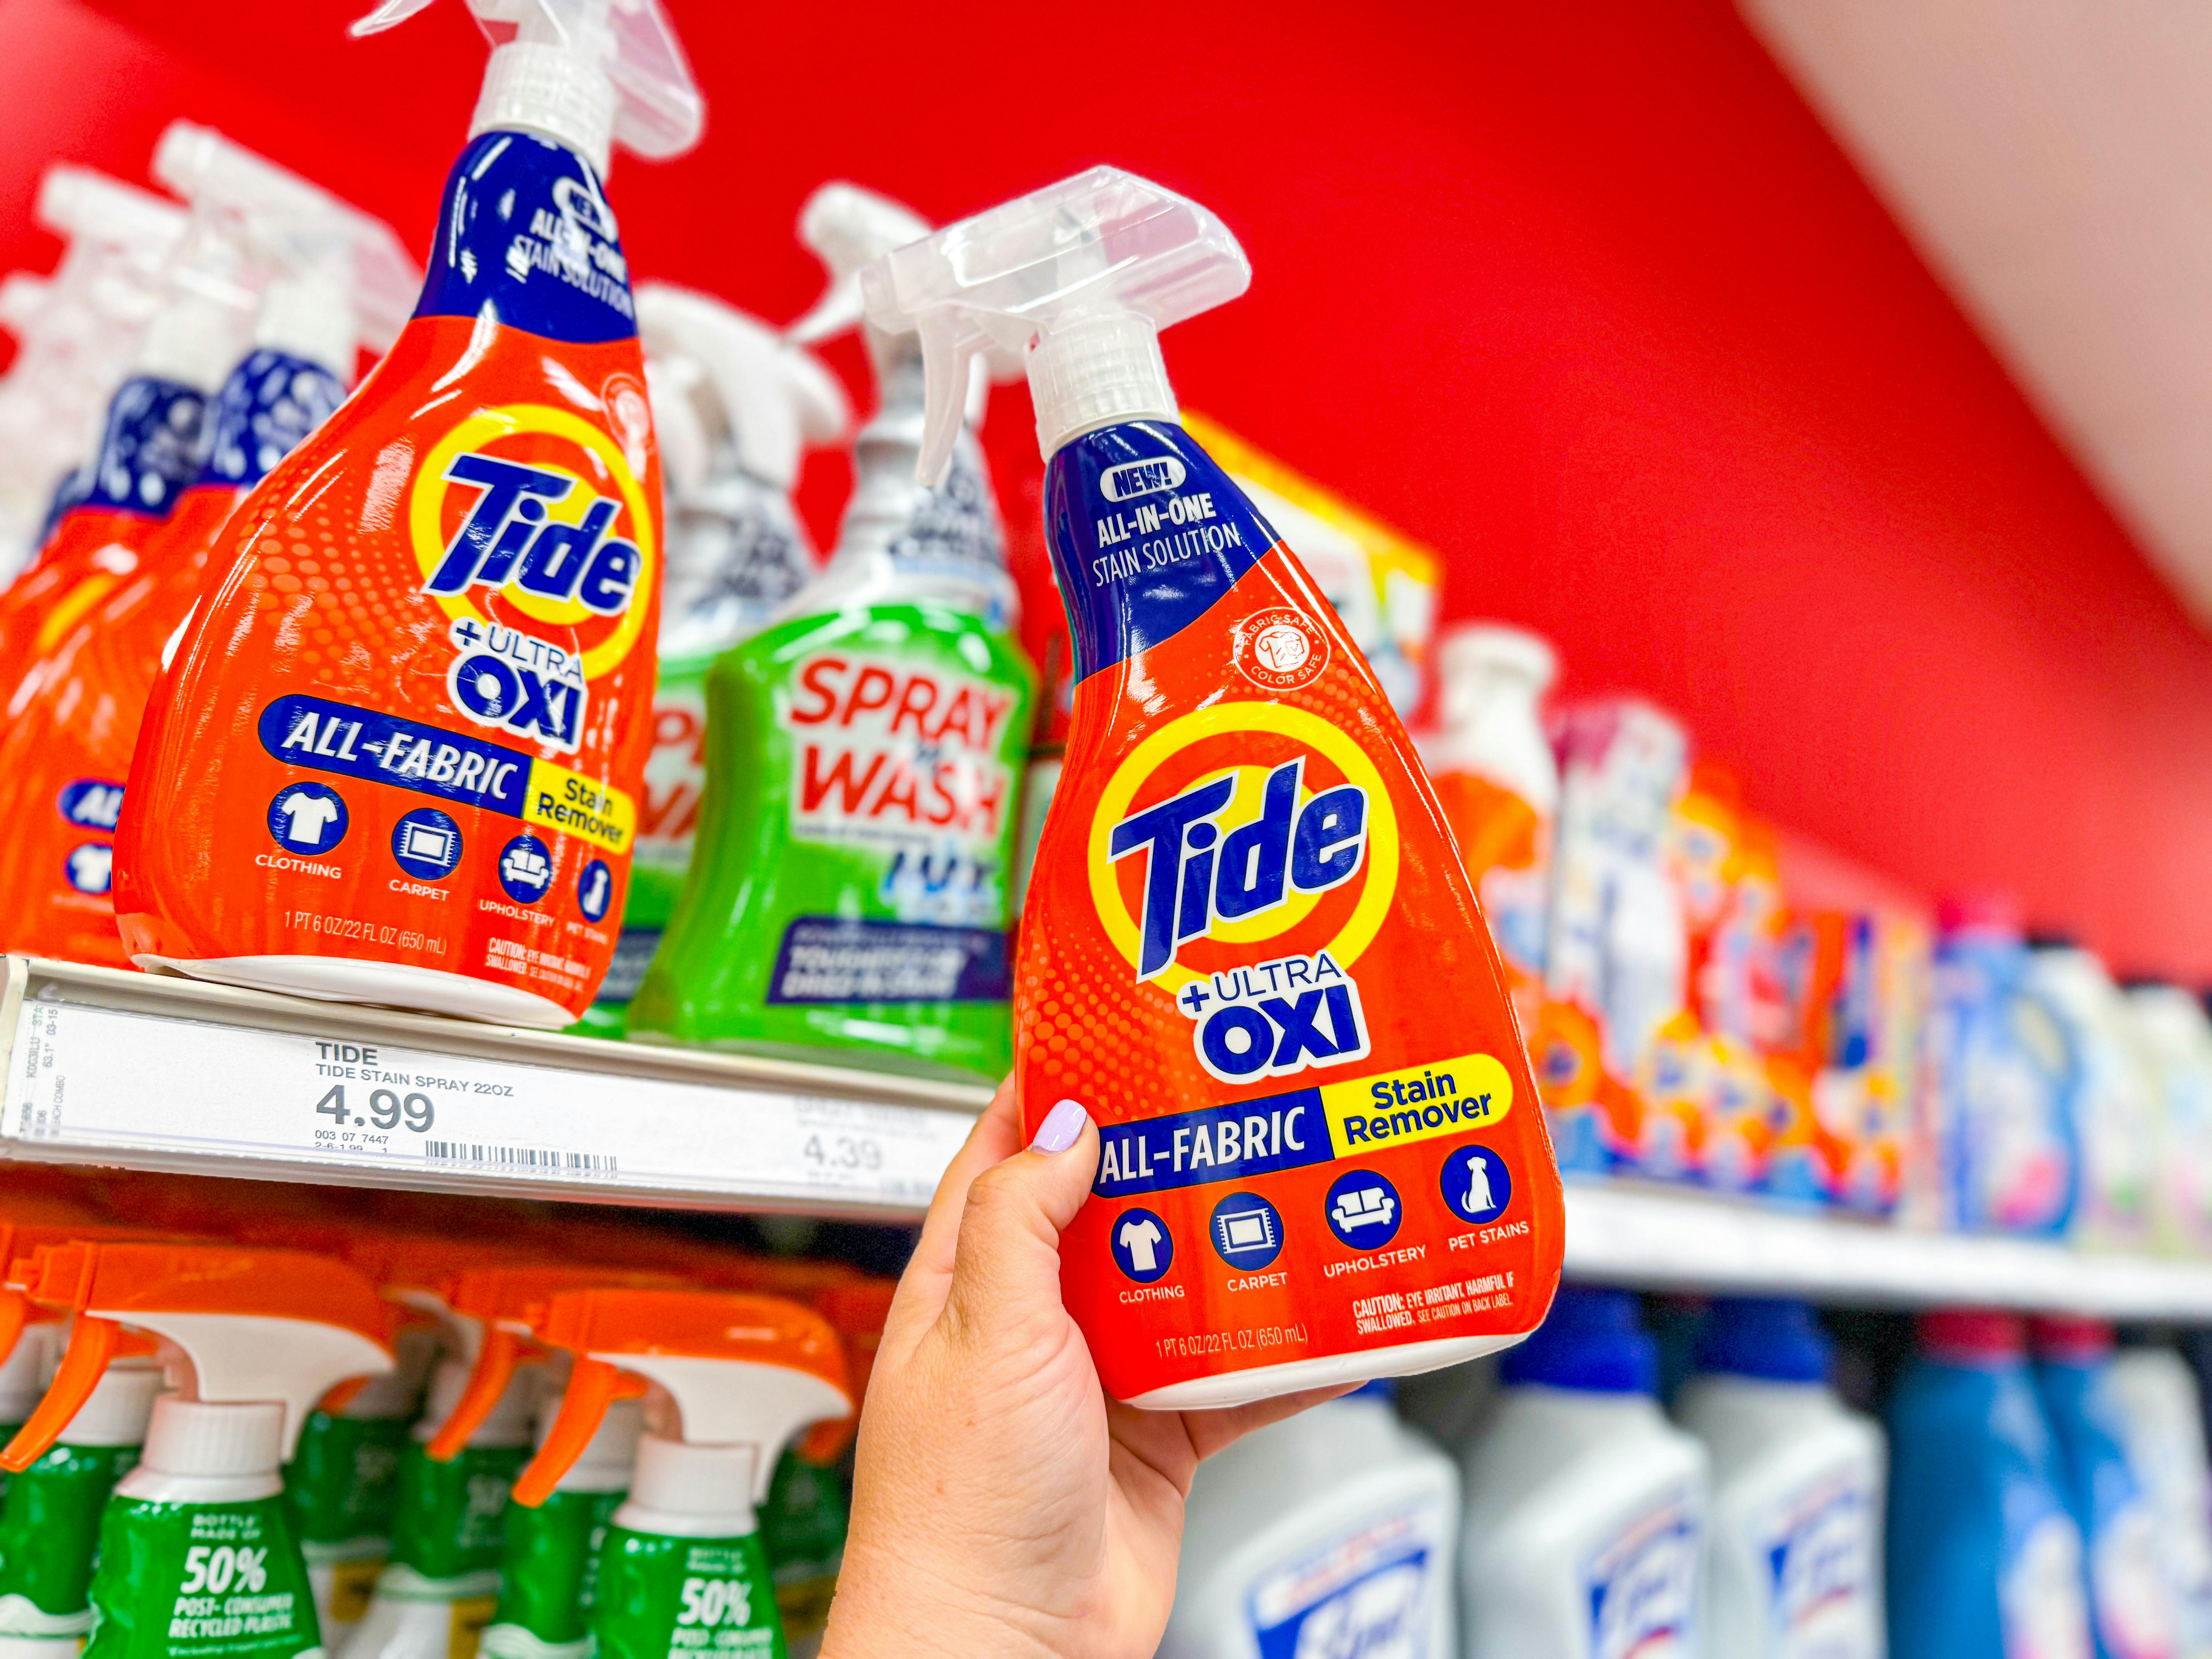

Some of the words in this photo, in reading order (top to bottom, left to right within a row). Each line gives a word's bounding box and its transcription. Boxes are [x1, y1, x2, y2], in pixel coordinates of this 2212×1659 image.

[514, 235, 560, 277] STAIN
[1112, 462, 1172, 497] NEW!
[429, 455, 639, 609] Tide
[1097, 493, 1216, 548] ALL-IN-ONE
[1093, 547, 1141, 587] STAIN
[1142, 522, 1241, 569] SOLUTION
[1244, 615, 1280, 646] FABRIC
[1284, 615, 1313, 634] SAFE
[1251, 666, 1295, 684] COLOR
[1298, 654, 1321, 680] SAFE
[457, 655, 582, 745] OXI
[792, 659, 1011, 752] SPRAY
[281, 712, 518, 799] ALL-FABRIC
[564, 778, 612, 816] Stan
[802, 746, 1005, 835] WASH
[537, 792, 623, 844] Remover
[255, 854, 341, 879] CLOTHING
[1112, 763, 1363, 976] Tide
[389, 879, 450, 901] CARPET
[480, 899, 555, 926] UPHOLSTERY
[285, 911, 290, 927] 1
[294, 912, 311, 929] PT
[313, 915, 321, 931] 6
[325, 917, 361, 938] OZ/22
[363, 923, 377, 941] FL
[381, 926, 397, 944] OZ
[398, 931, 424, 950] (650
[426, 937, 447, 957] mL)
[489, 937, 526, 960] CAUTION:
[527, 949, 539, 963] EYE
[486, 954, 527, 974] SWALLOWED.
[46, 1009, 58, 1035] 03-15
[1202, 984, 1360, 1075] OXI
[316, 1042, 378, 1066] TIDE
[54, 1075, 65, 1103] COMBO
[316, 1063, 356, 1079] TIDE
[361, 1069, 410, 1085] STAIN
[416, 1076, 469, 1091] SPRAY
[474, 1083, 514, 1096] 22OZ
[316, 1084, 435, 1132] 4.99
[1343, 1093, 1492, 1145] Remover
[315, 1130, 336, 1140] 003
[342, 1132, 356, 1141] 07
[362, 1134, 388, 1144] 7447
[1100, 1106, 1305, 1184] ALL-FABRIC
[1371, 1071, 1456, 1109] Stain
[804, 1134, 883, 1170] 4.39
[1448, 1233, 1476, 1251] PET
[1479, 1221, 1529, 1243] STAINS
[1324, 1245, 1427, 1277] UPHOLSTERY
[1120, 1285, 1185, 1303] CLOTHING
[1227, 1272, 1287, 1292] CARPET
[1353, 1292, 1405, 1318] CAUTION:
[1406, 1291, 1424, 1309] EYE
[1465, 1274, 1505, 1296] HARMFUL
[1506, 1271, 1514, 1287] IF
[1356, 1313, 1415, 1334] SWALLOWED.
[1417, 1309, 1430, 1323] SEE
[1432, 1303, 1461, 1320] CAUTION
[1462, 1299, 1472, 1314] ON
[1472, 1297, 1491, 1312] BACK
[1491, 1292, 1513, 1309] LABEL.
[1156, 1340, 1162, 1359] 1
[1164, 1338, 1176, 1357] PT
[1179, 1338, 1187, 1355] 6
[1188, 1334, 1221, 1354] OZ/22
[1222, 1332, 1237, 1351] FL
[1238, 1330, 1254, 1348] OZ
[1257, 1326, 1282, 1350] (650
[1285, 1322, 1308, 1344] mL)
[180, 1546, 268, 1594] 50%
[173, 1597, 221, 1616] POST-
[677, 1577, 752, 1626] 50%
[168, 1617, 243, 1638] RECYCLED
